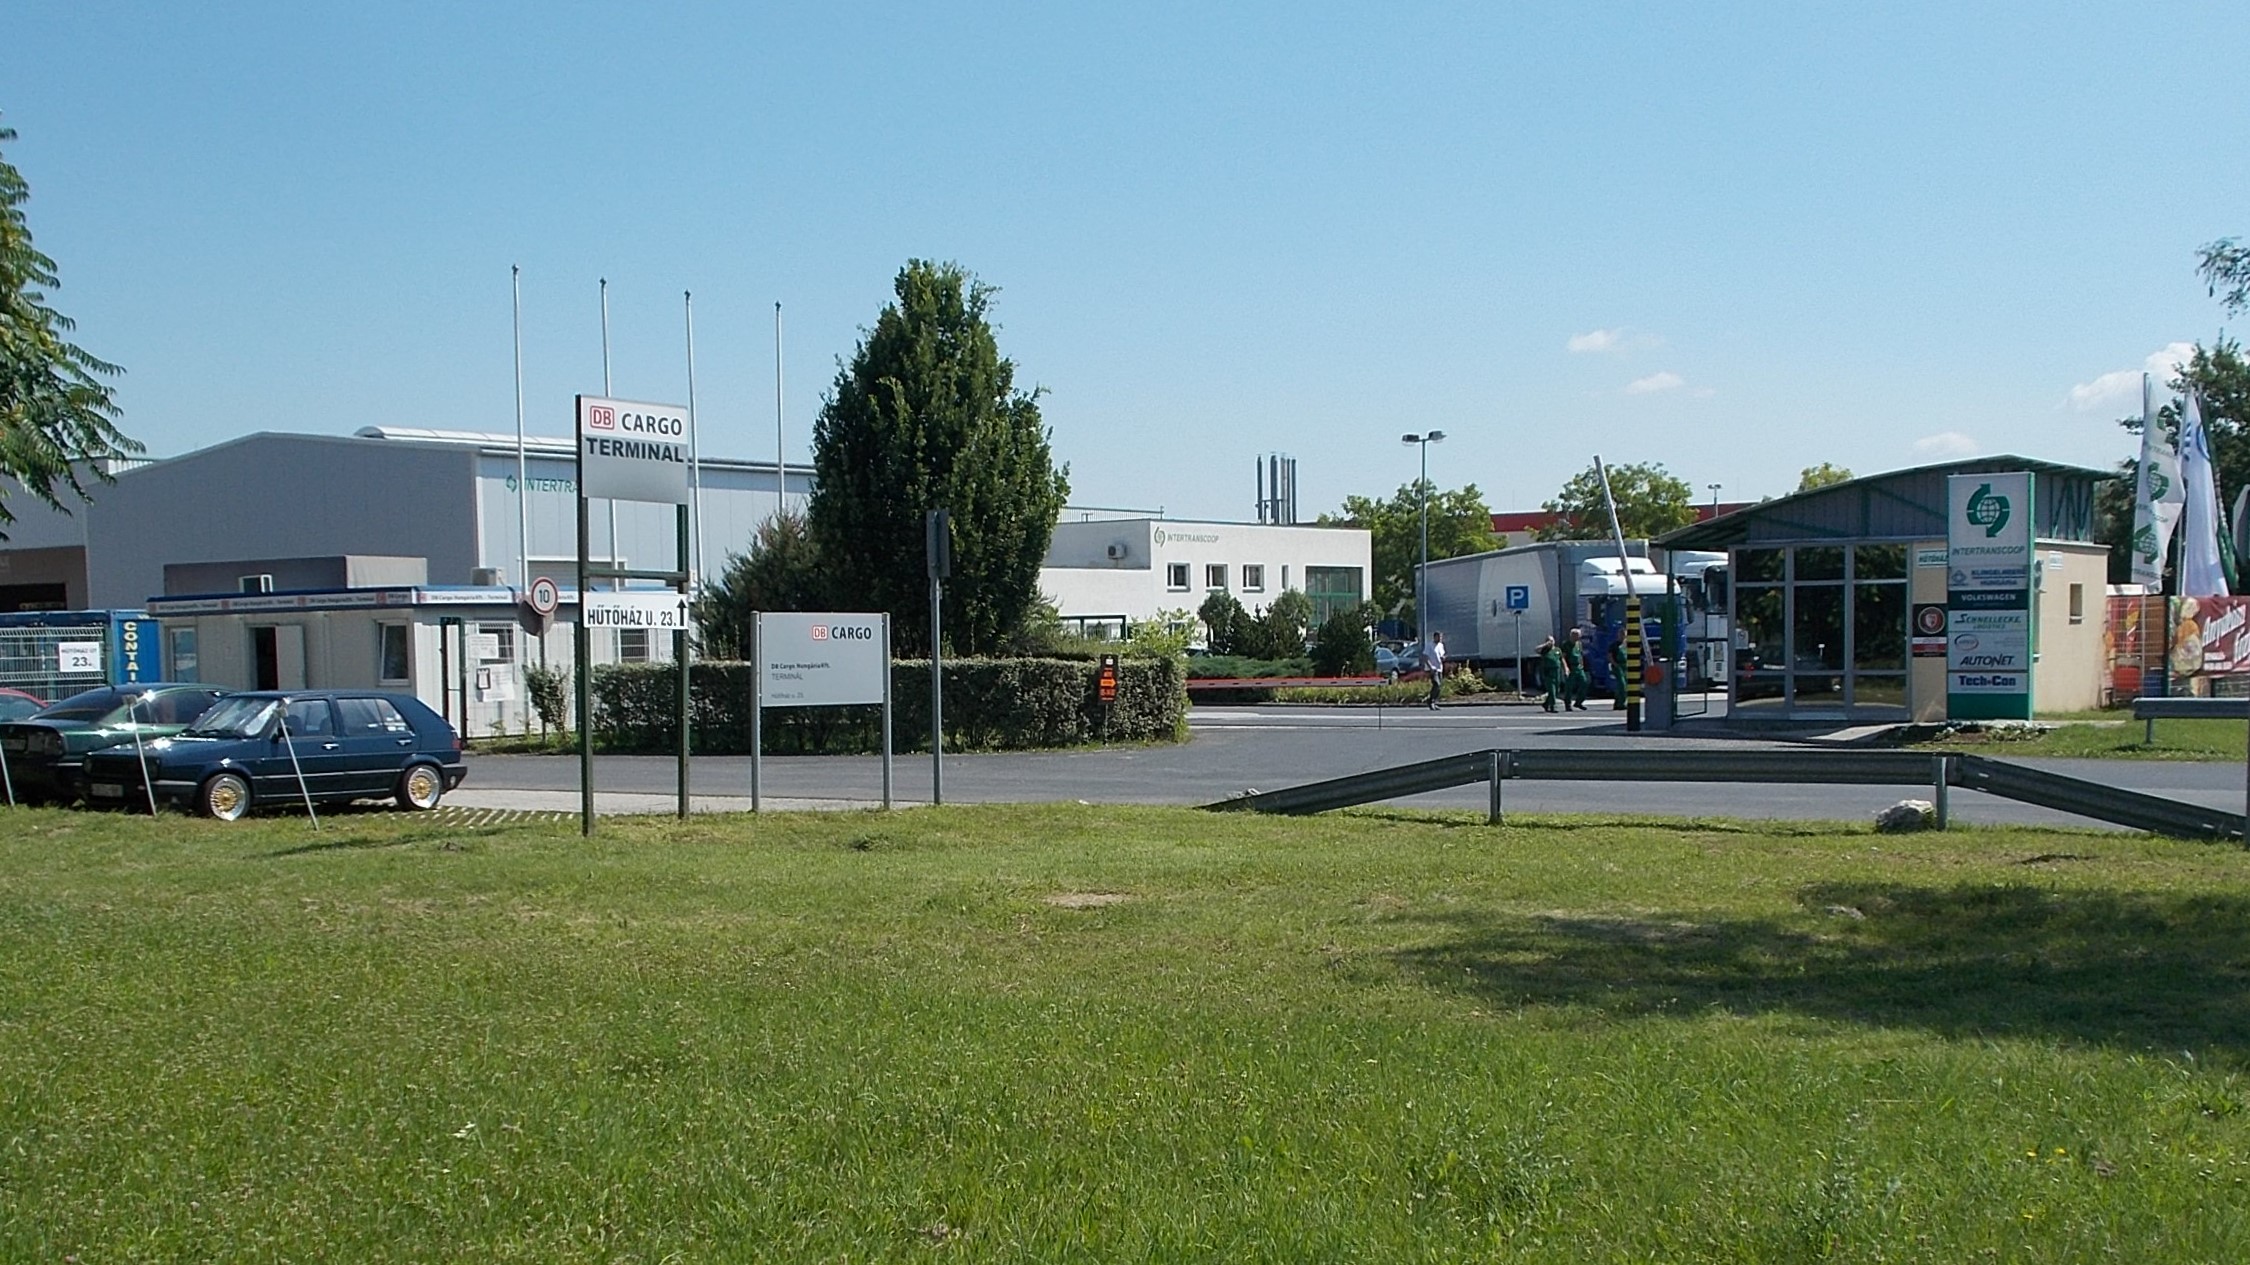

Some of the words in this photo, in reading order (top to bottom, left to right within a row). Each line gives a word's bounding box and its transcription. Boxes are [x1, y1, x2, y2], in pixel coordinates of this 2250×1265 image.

[592, 409, 613, 426] DB
[621, 412, 683, 436] CARGO
[585, 436, 685, 464] TERMINÁL
[1167, 533, 1219, 543] INTERTRANSCOOP
[1952, 545, 2025, 556] INTERTRANSCOOP
[538, 589, 550, 604] 10
[1510, 588, 1524, 607] P
[1961, 593, 2017, 601] VOLKSWAGEN
[587, 604, 643, 626] HŰTŐHÁZ
[645, 610, 657, 626] U.
[660, 611, 677, 627] 23.
[813, 627, 827, 639] DB
[831, 626, 872, 640] CARGO
[72, 656, 93, 668] 23.
[780, 663, 796, 671] Cargo
[772, 672, 804, 681] TERMINÁL
